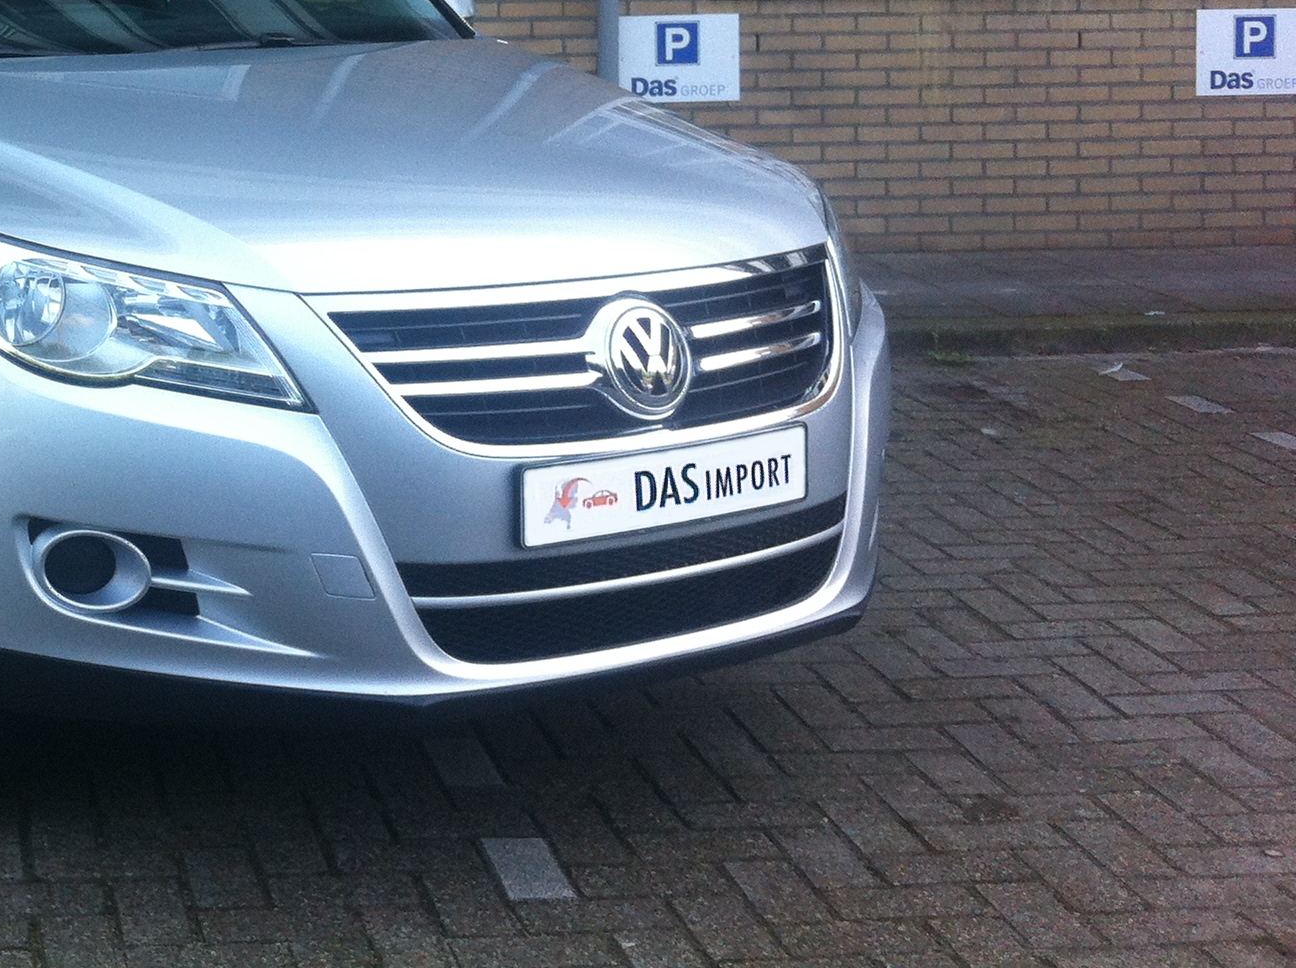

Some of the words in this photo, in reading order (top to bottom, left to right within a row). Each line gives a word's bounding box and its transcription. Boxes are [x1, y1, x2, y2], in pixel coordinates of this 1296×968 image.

[664, 26, 691, 61] P
[1243, 20, 1268, 54] P
[630, 77, 678, 97] Das
[680, 84, 726, 97] GROEP
[1210, 70, 1254, 90] Das
[634, 462, 700, 512] DAS
[705, 453, 792, 501] IMPORT
